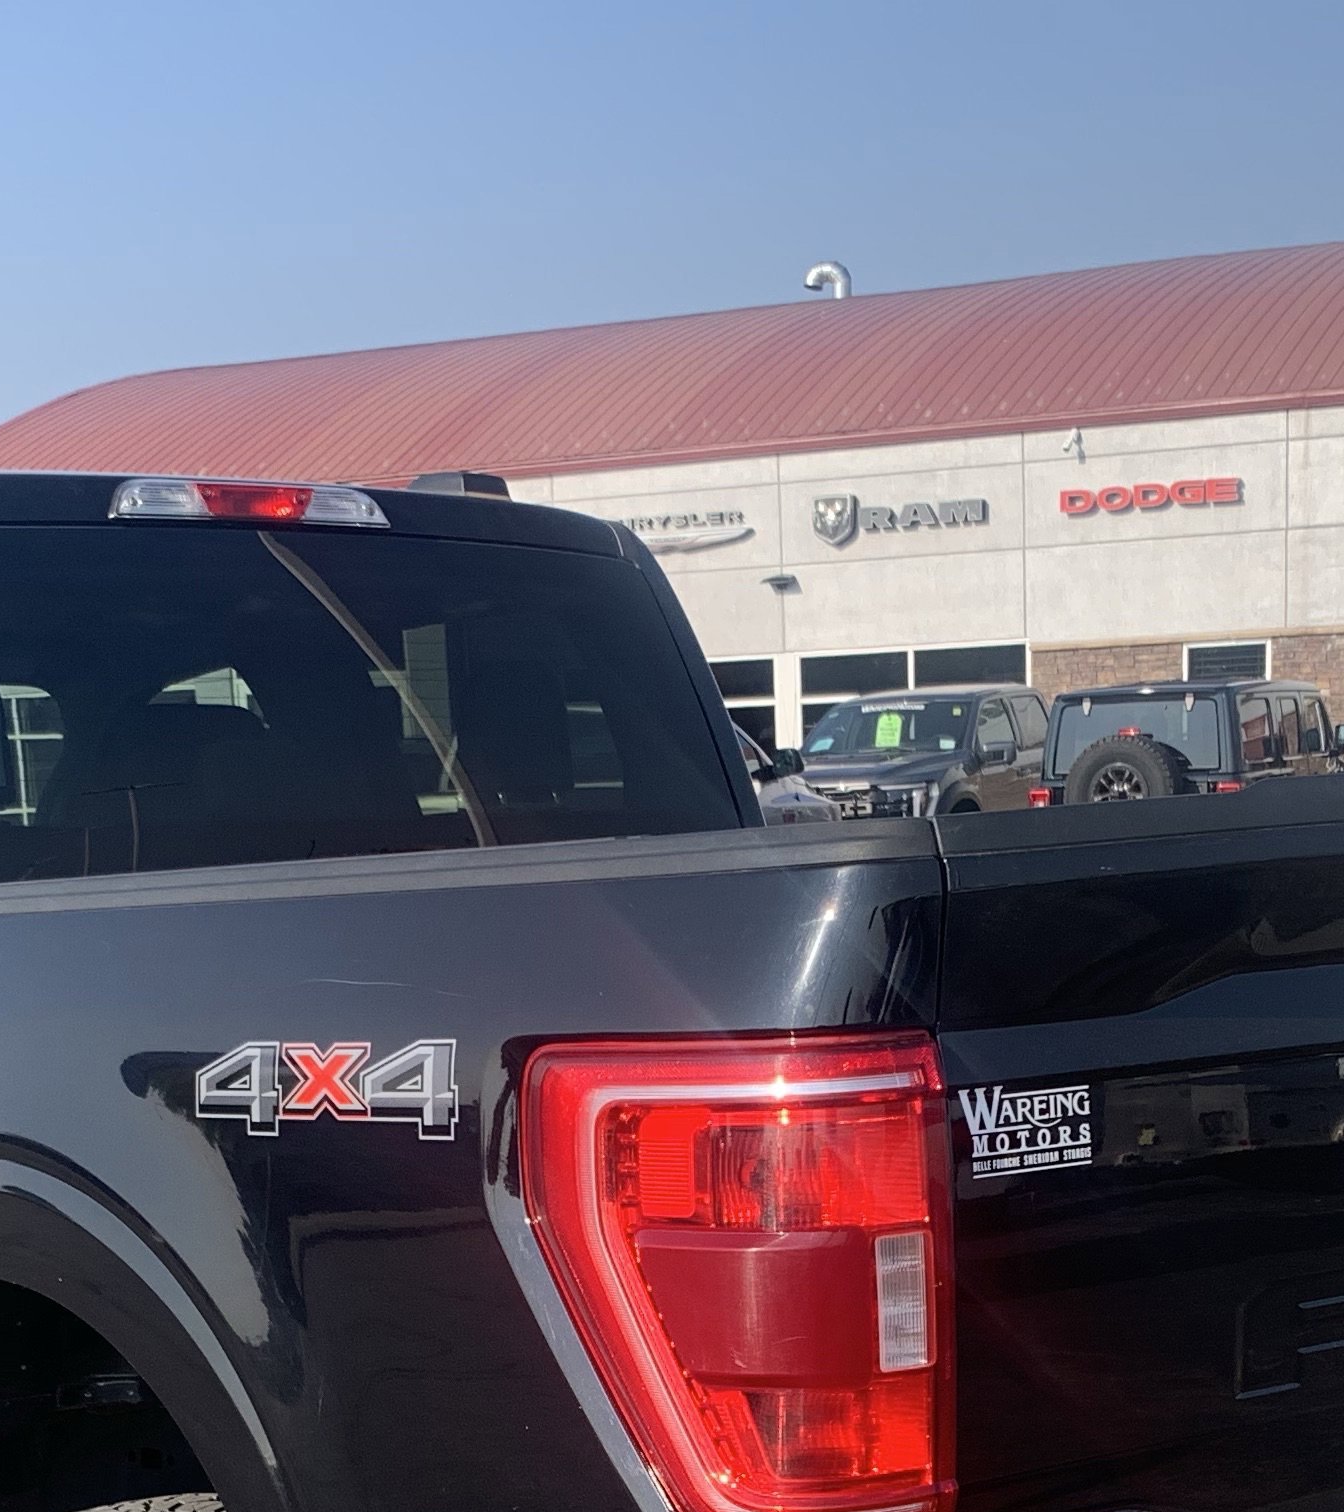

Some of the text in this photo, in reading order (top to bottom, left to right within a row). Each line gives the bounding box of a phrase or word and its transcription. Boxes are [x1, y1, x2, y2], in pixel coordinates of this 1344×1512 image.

[1059, 477, 1242, 514] DODGE
[621, 510, 745, 531] HRYSLER
[860, 499, 988, 532] RAM
[958, 1085, 1092, 1135] WAREING
[972, 1122, 1092, 1157] MOTORS
[972, 1160, 992, 1172] BELLE
[1023, 1150, 1060, 1166] SHERIDAN
